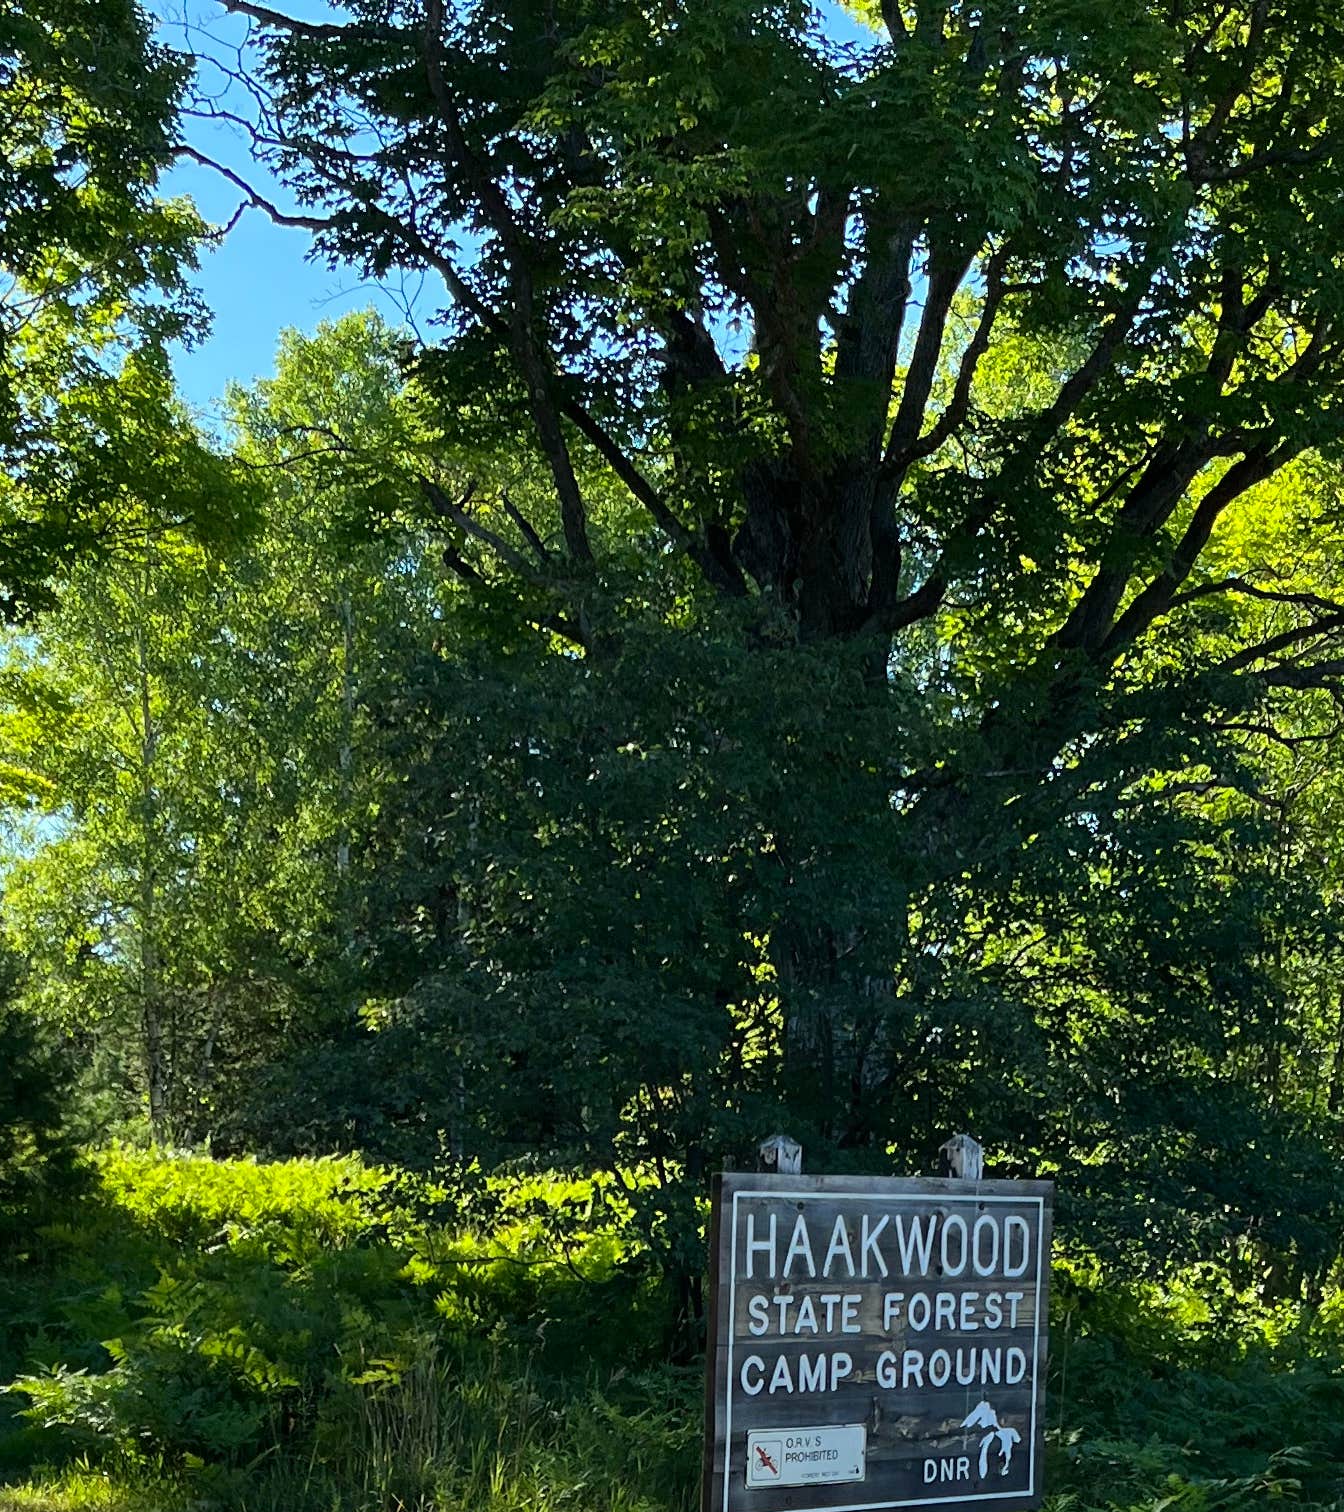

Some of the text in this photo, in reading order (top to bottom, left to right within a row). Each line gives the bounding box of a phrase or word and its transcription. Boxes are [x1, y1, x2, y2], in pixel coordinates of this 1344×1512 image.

[746, 1213, 1030, 1279] HAAKWOOD
[748, 1291, 1024, 1337] STATE FOREST
[740, 1346, 1027, 1395] CAMP GROUND
[785, 1449, 839, 1463] PROHIBITED
[923, 1456, 970, 1484] DNR
